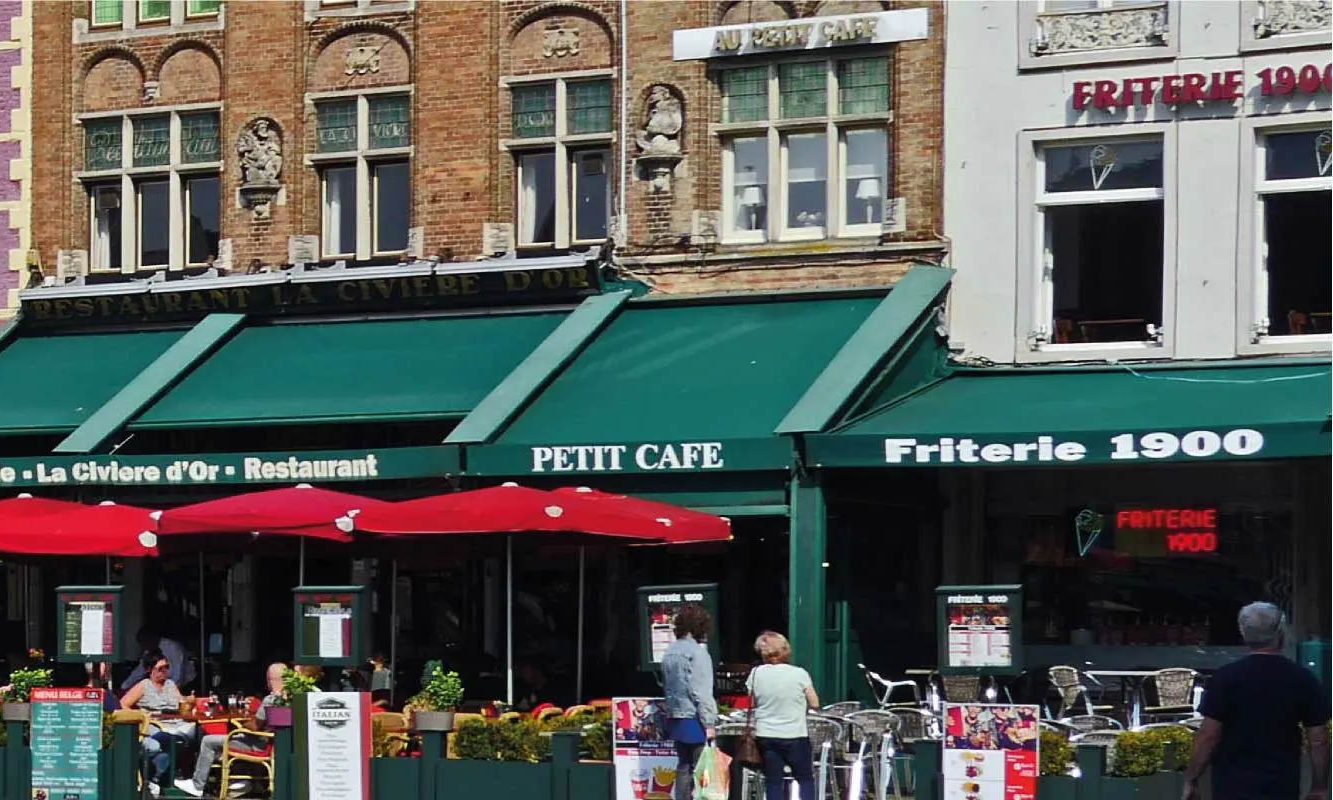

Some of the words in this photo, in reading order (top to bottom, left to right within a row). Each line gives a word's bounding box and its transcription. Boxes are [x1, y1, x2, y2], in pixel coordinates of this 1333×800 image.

[715, 30, 742, 51] AU
[818, 17, 878, 41] CAFE
[1072, 70, 1243, 110] FRITERIE
[35, 287, 250, 320] RESTAURANT
[273, 284, 318, 306] LA
[338, 273, 480, 301] CIVIERE
[531, 445, 626, 472] PETIT
[635, 442, 724, 470] CAFE
[884, 436, 1087, 463] Friterie
[1110, 429, 1264, 459] 1900
[36, 463, 67, 483] La
[72, 461, 161, 482] Civiere
[166, 460, 219, 481] d'Or
[244, 454, 378, 480] Restaurant
[1117, 508, 1217, 529] FRITERIE
[1166, 533, 1217, 552] 1900
[34, 690, 58, 699] MENU
